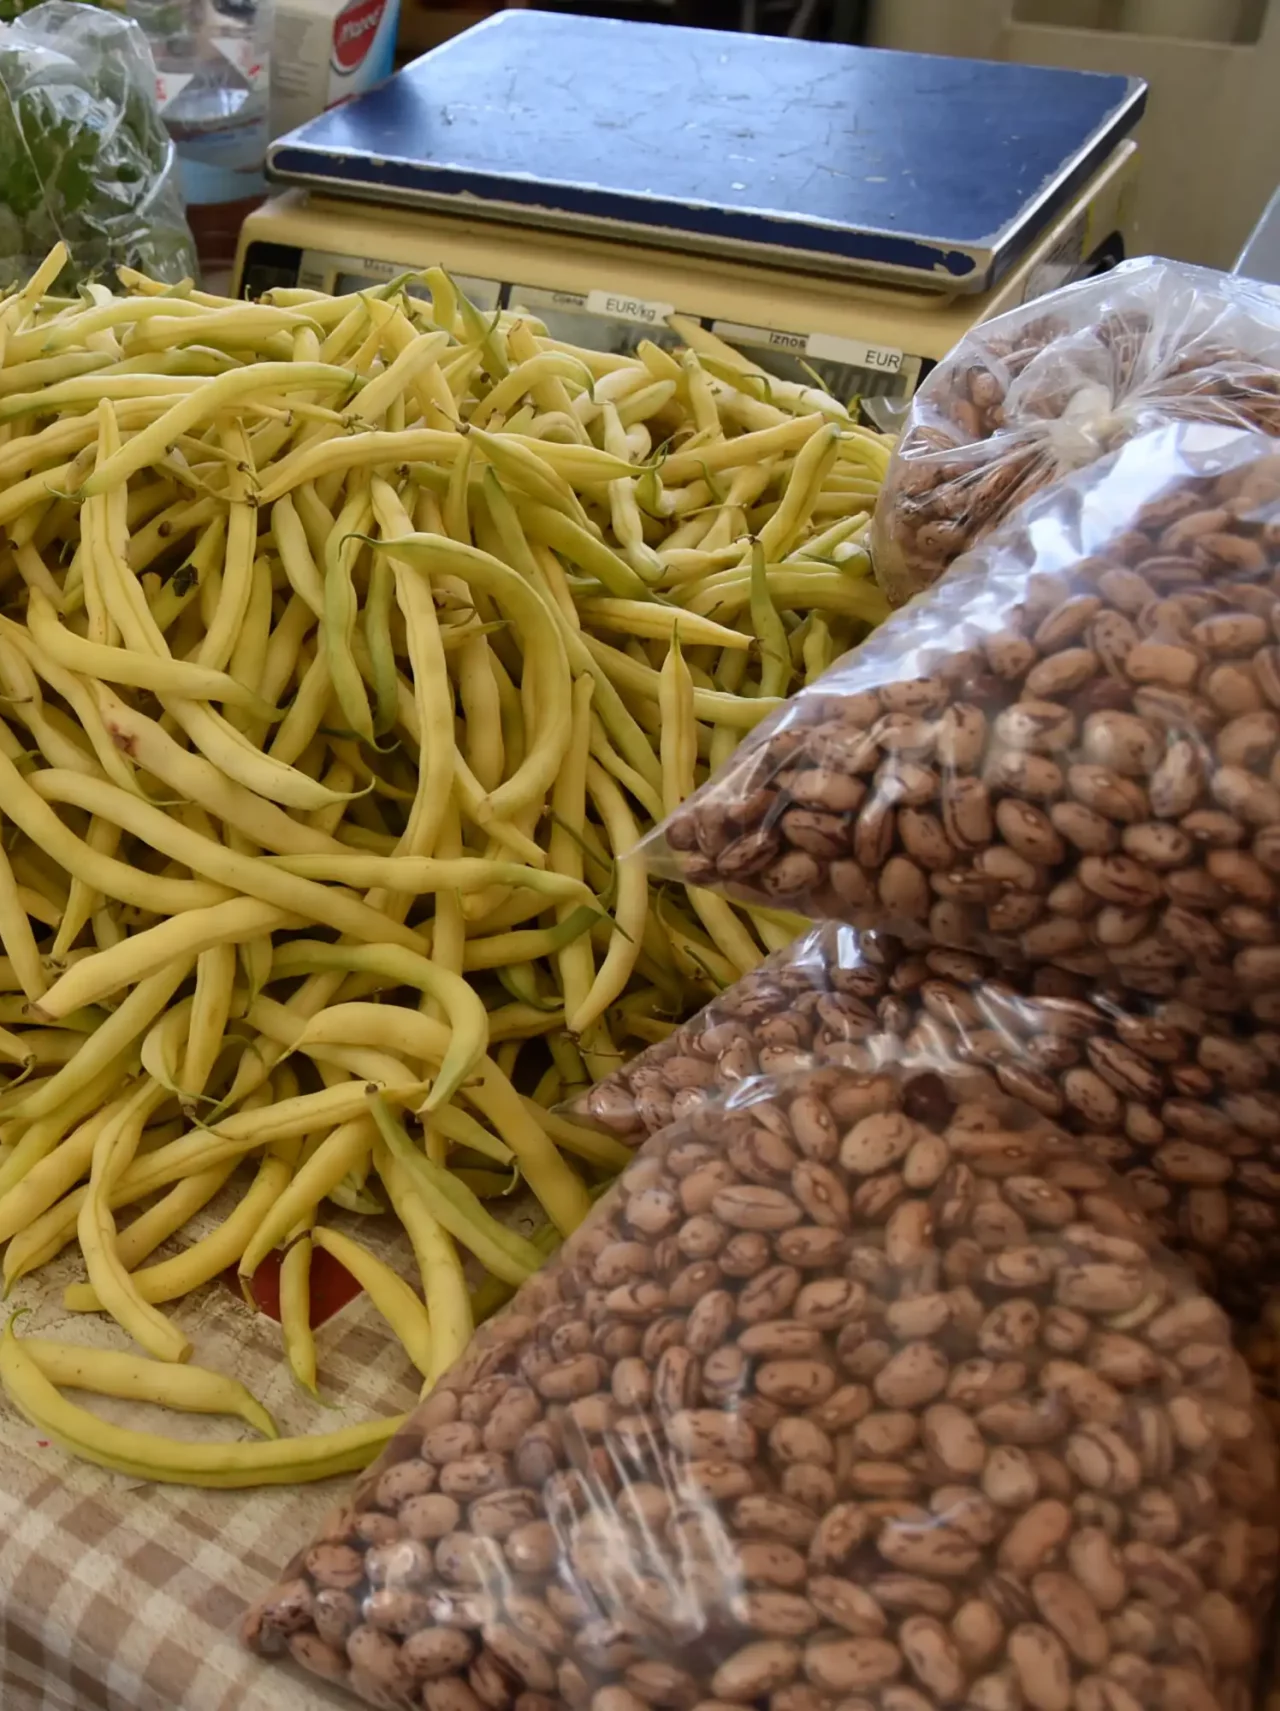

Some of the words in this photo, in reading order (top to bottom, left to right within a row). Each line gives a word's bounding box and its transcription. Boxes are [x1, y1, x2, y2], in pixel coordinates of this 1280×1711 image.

[605, 296, 657, 323] EUR/kg
[769, 332, 808, 350] Iznos
[864, 349, 901, 369] EUR
